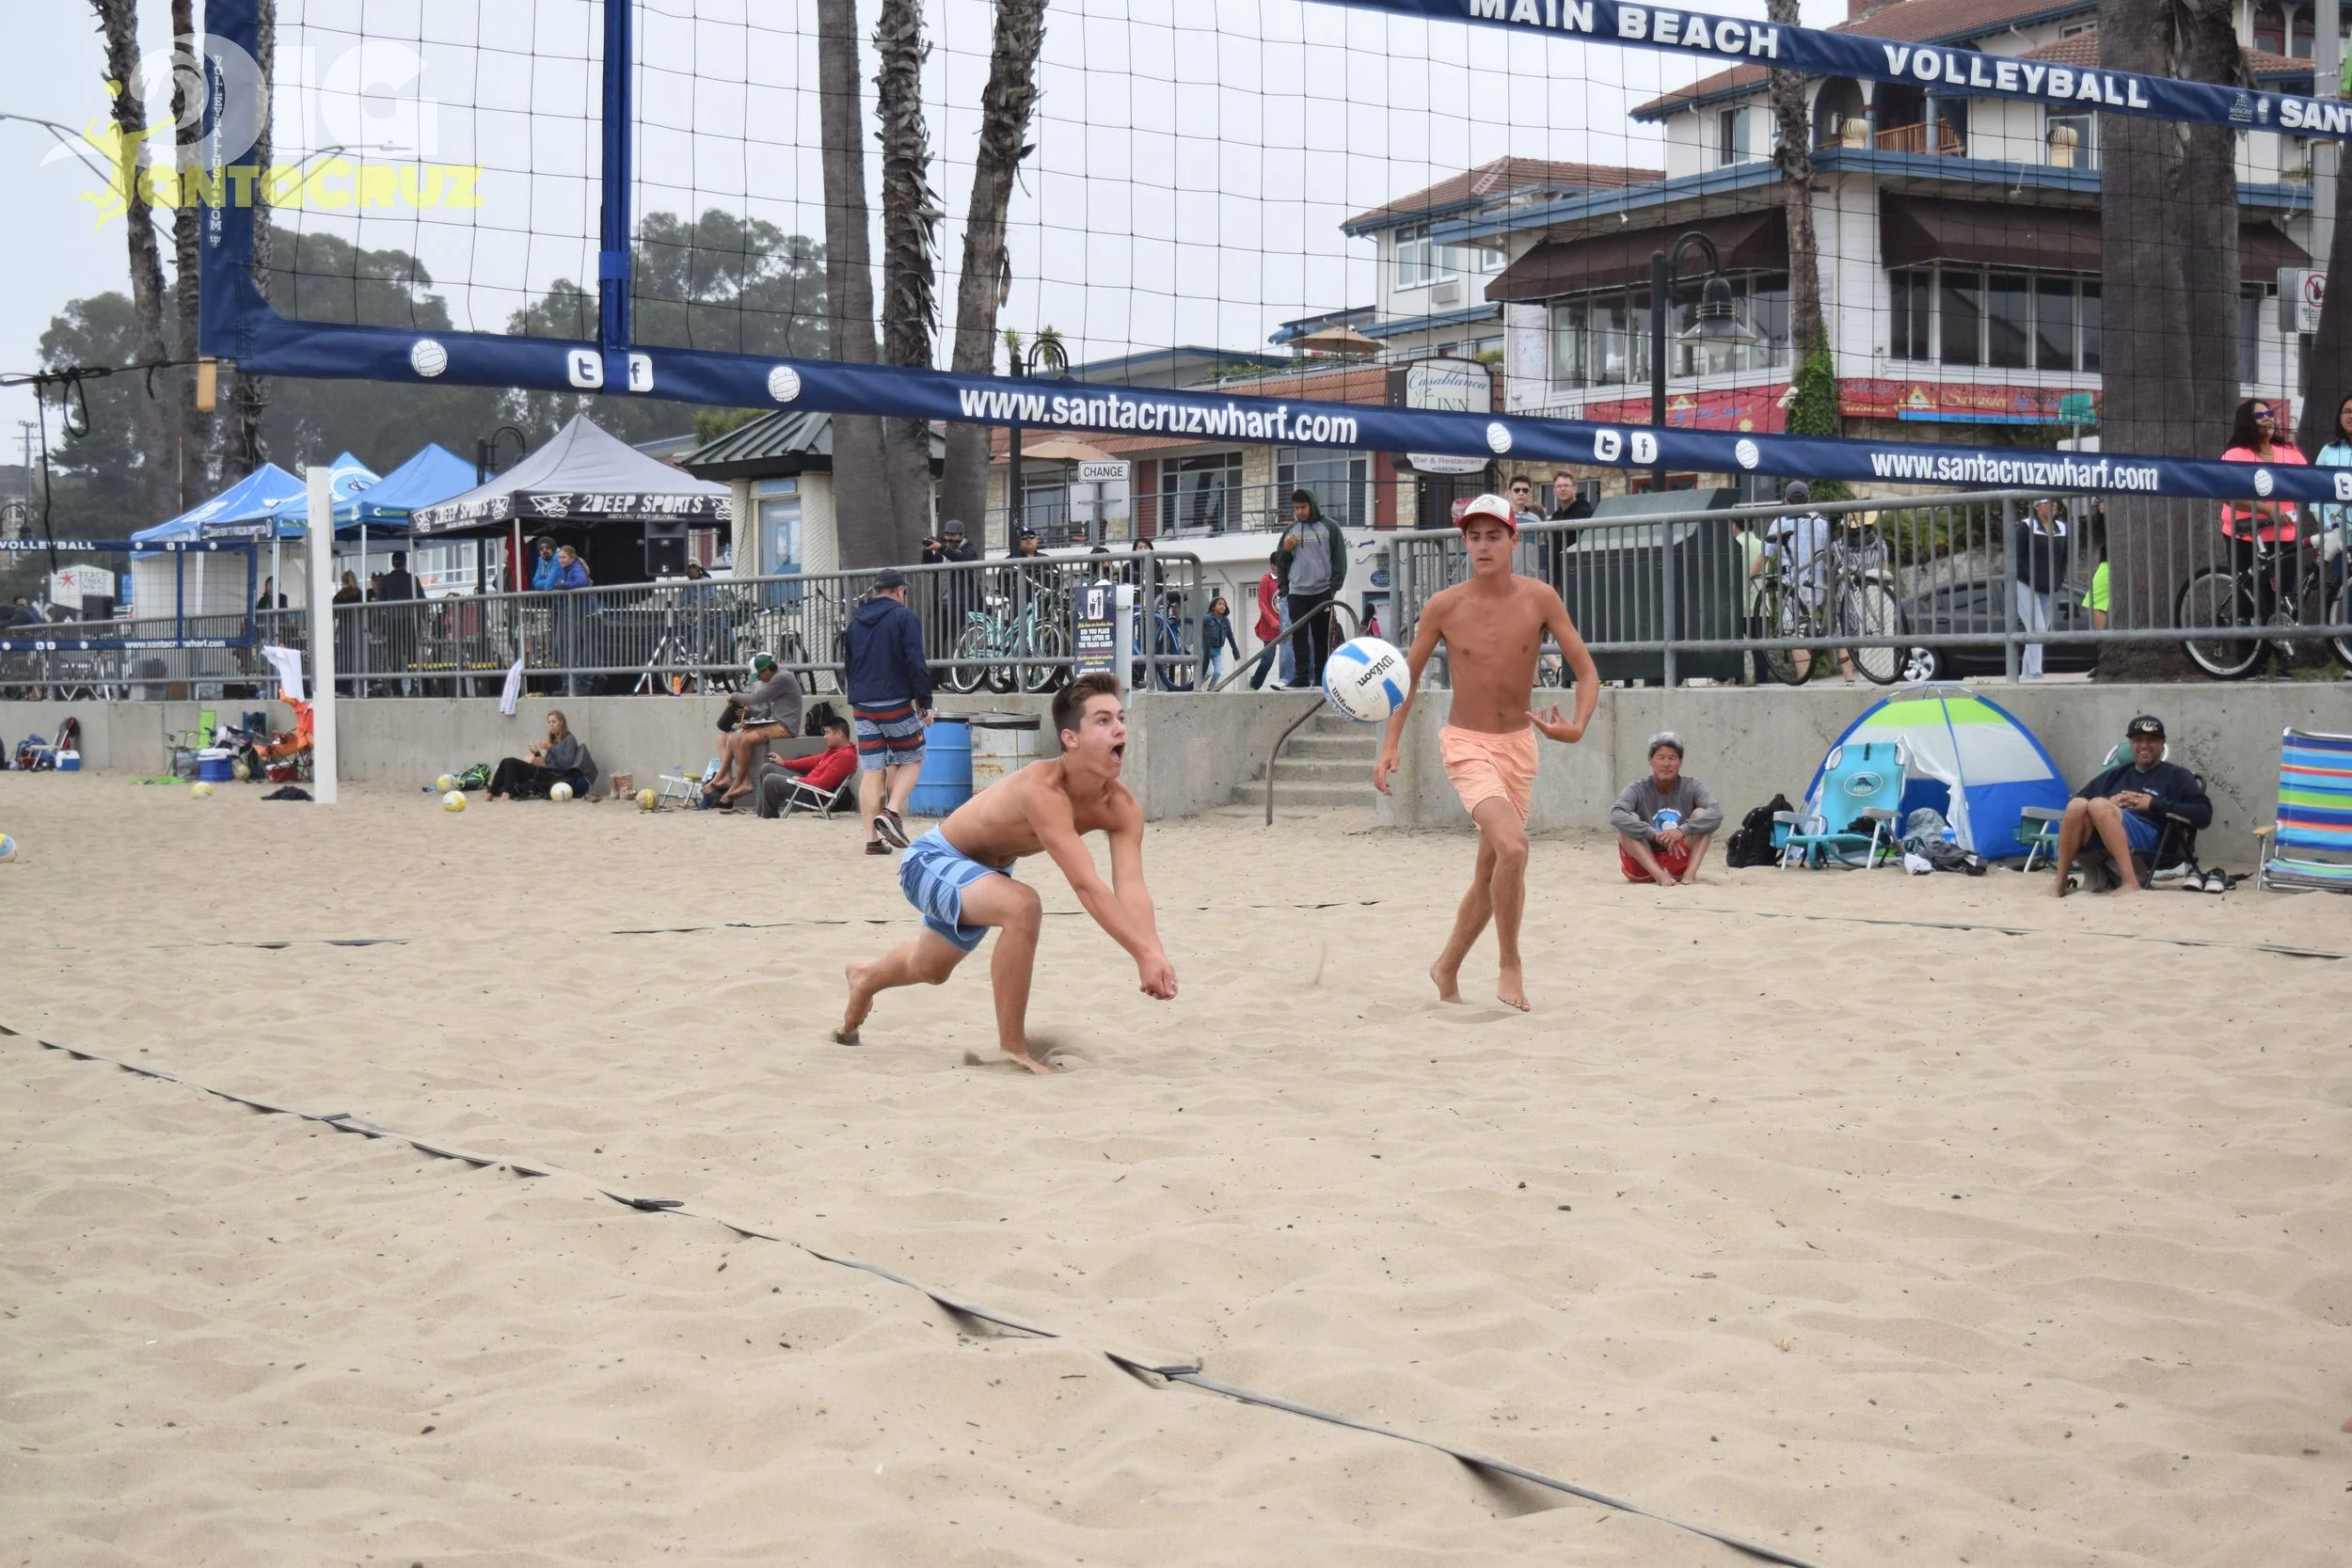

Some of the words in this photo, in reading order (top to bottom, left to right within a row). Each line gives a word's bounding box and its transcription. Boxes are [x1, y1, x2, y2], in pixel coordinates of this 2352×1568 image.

[1469, 0, 1594, 33] MAIN
[1617, 6, 1778, 59] BEACH
[1883, 45, 2149, 109] VOLLEYBALL
[1407, 365, 1487, 389] Casablanca
[960, 388, 1358, 444] www.santacruzwharf.com
[1438, 397, 1470, 412] INN
[1083, 466, 1123, 478] CHANGE
[1438, 457, 1482, 466] Restaurant
[1870, 452, 2158, 491] www.santacruzwharf.com
[580, 494, 637, 513] 2DEEP
[641, 494, 704, 514] SPORTS
[1356, 654, 1395, 687] Wilson
[1331, 686, 1356, 715] Wilson
